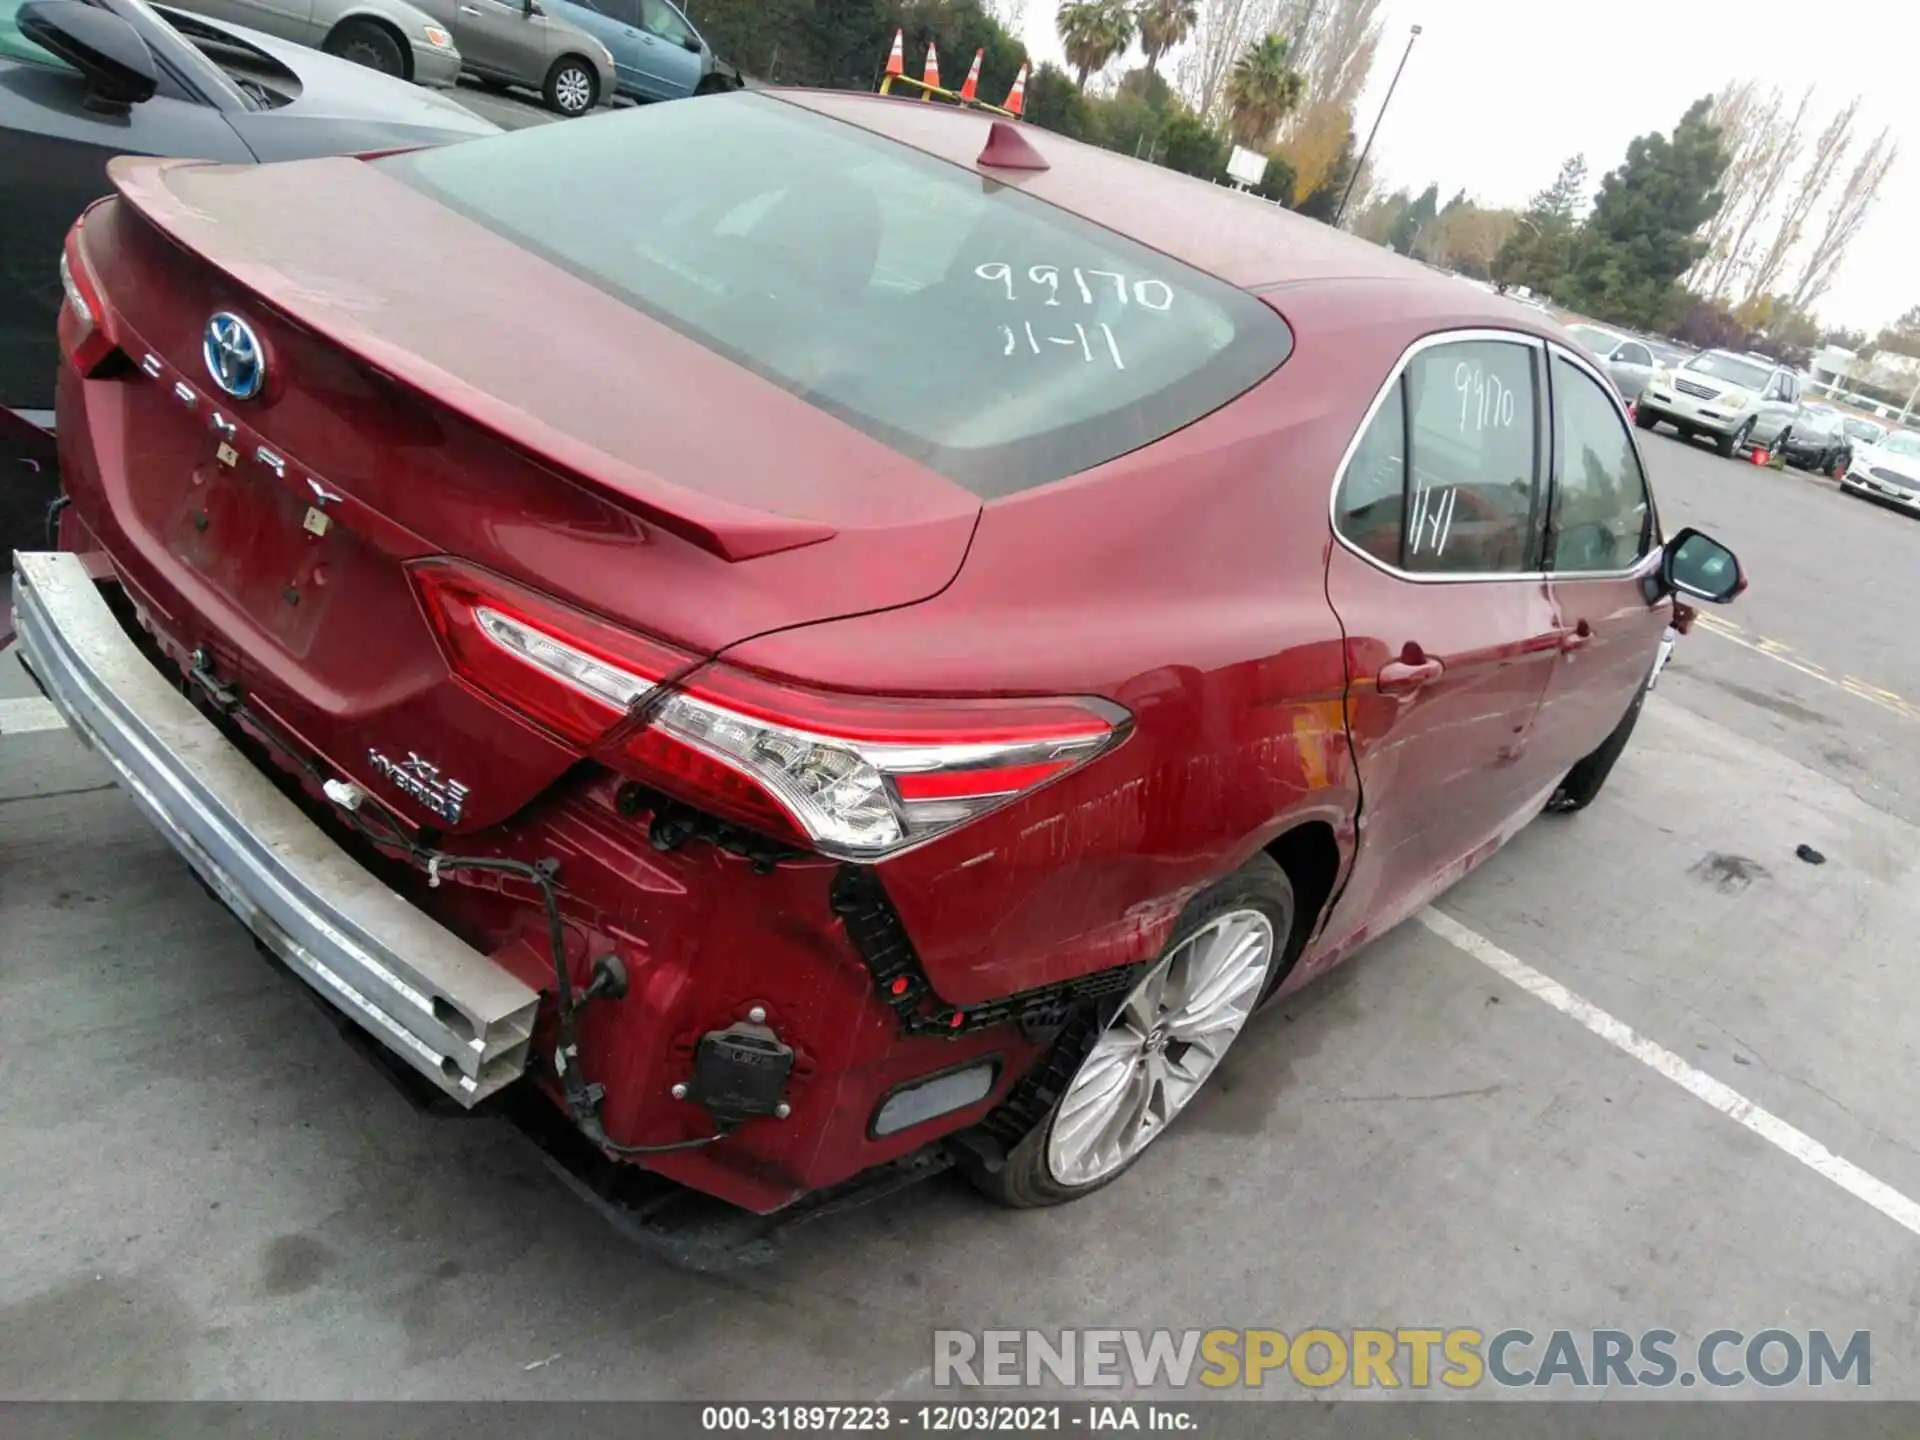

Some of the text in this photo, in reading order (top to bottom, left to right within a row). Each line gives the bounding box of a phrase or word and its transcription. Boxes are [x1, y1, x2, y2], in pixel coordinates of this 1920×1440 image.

[974, 262, 1175, 311] 99170
[1453, 361, 1515, 434] 99170
[401, 750, 471, 802] XLE
